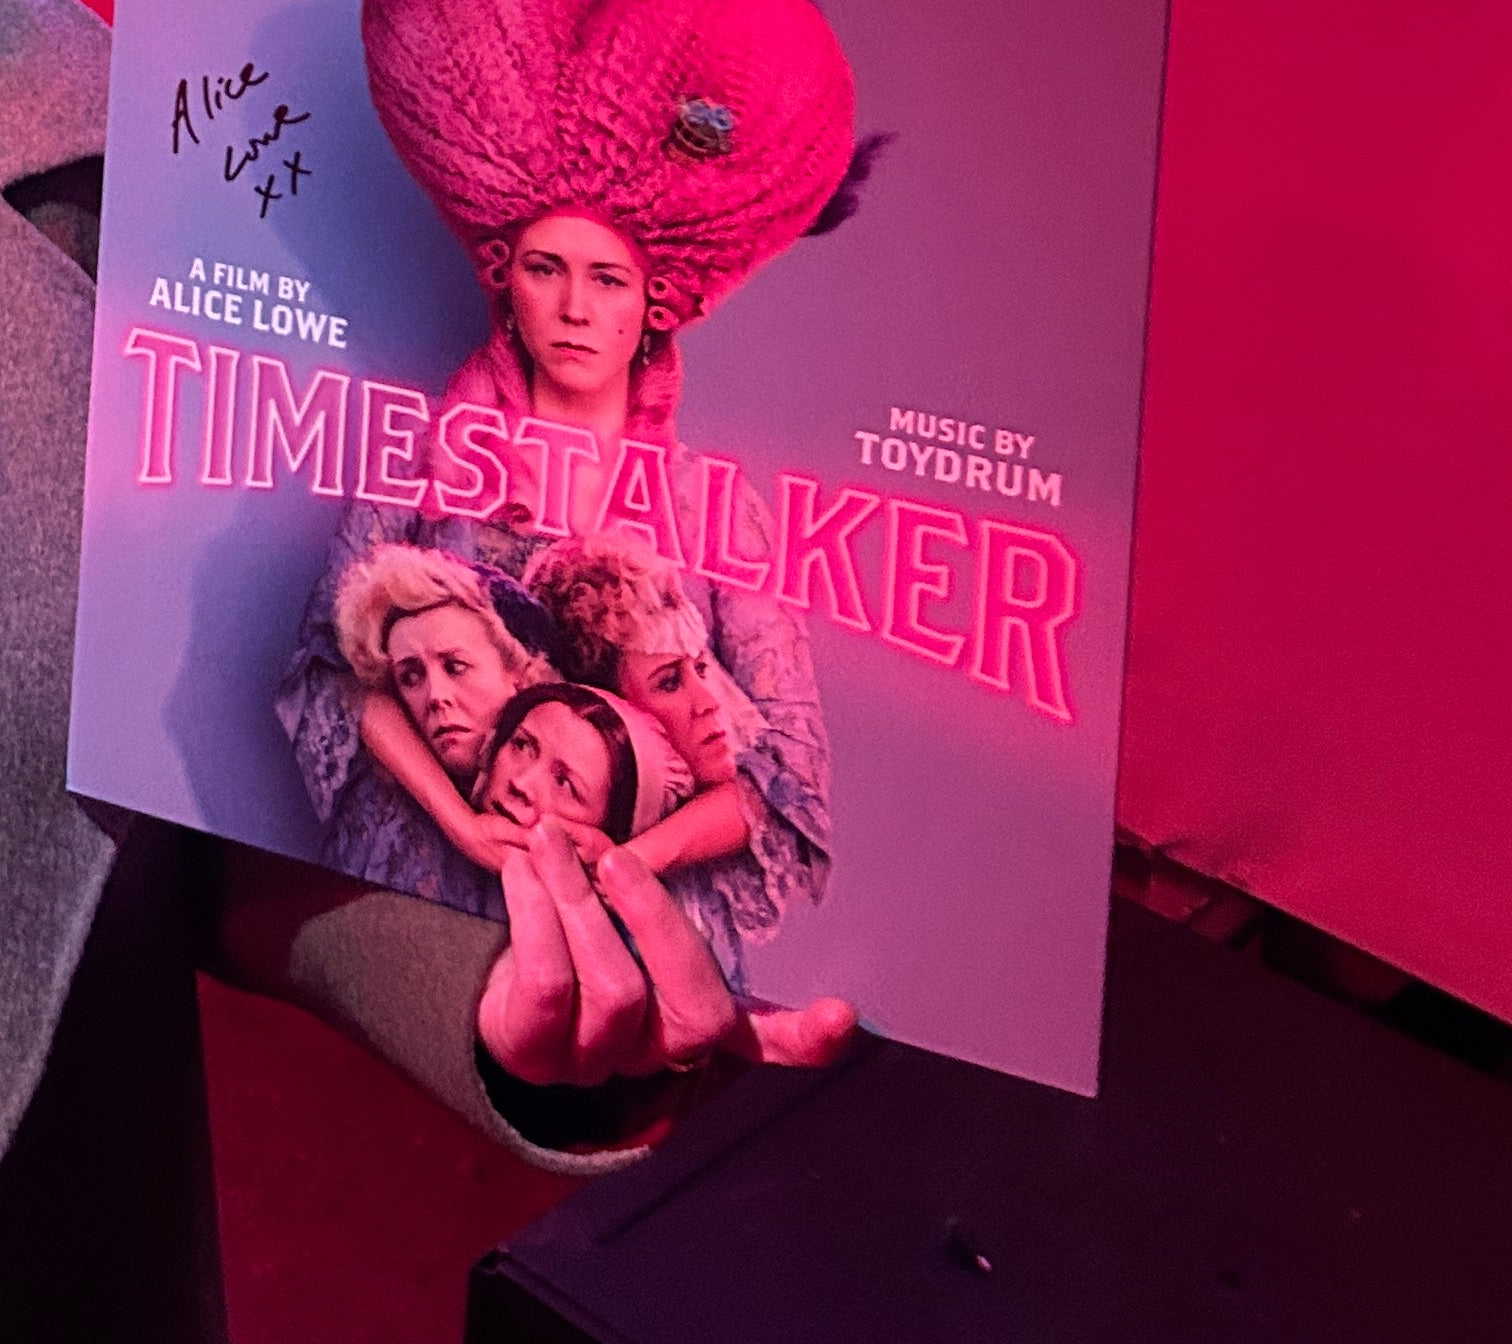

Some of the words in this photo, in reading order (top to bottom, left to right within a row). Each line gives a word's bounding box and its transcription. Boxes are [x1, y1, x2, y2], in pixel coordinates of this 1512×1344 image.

[171, 62, 269, 154] Alice
[149, 276, 242, 326] ALICE
[253, 298, 348, 348] LOWE
[189, 257, 207, 282] A
[212, 261, 270, 297] FILM
[277, 274, 311, 304] BY
[854, 430, 1064, 507] TOYDRUM
[889, 406, 986, 450] MUSIC
[994, 427, 1036, 460] BY
[123, 326, 1075, 721] TIMESTALKER
